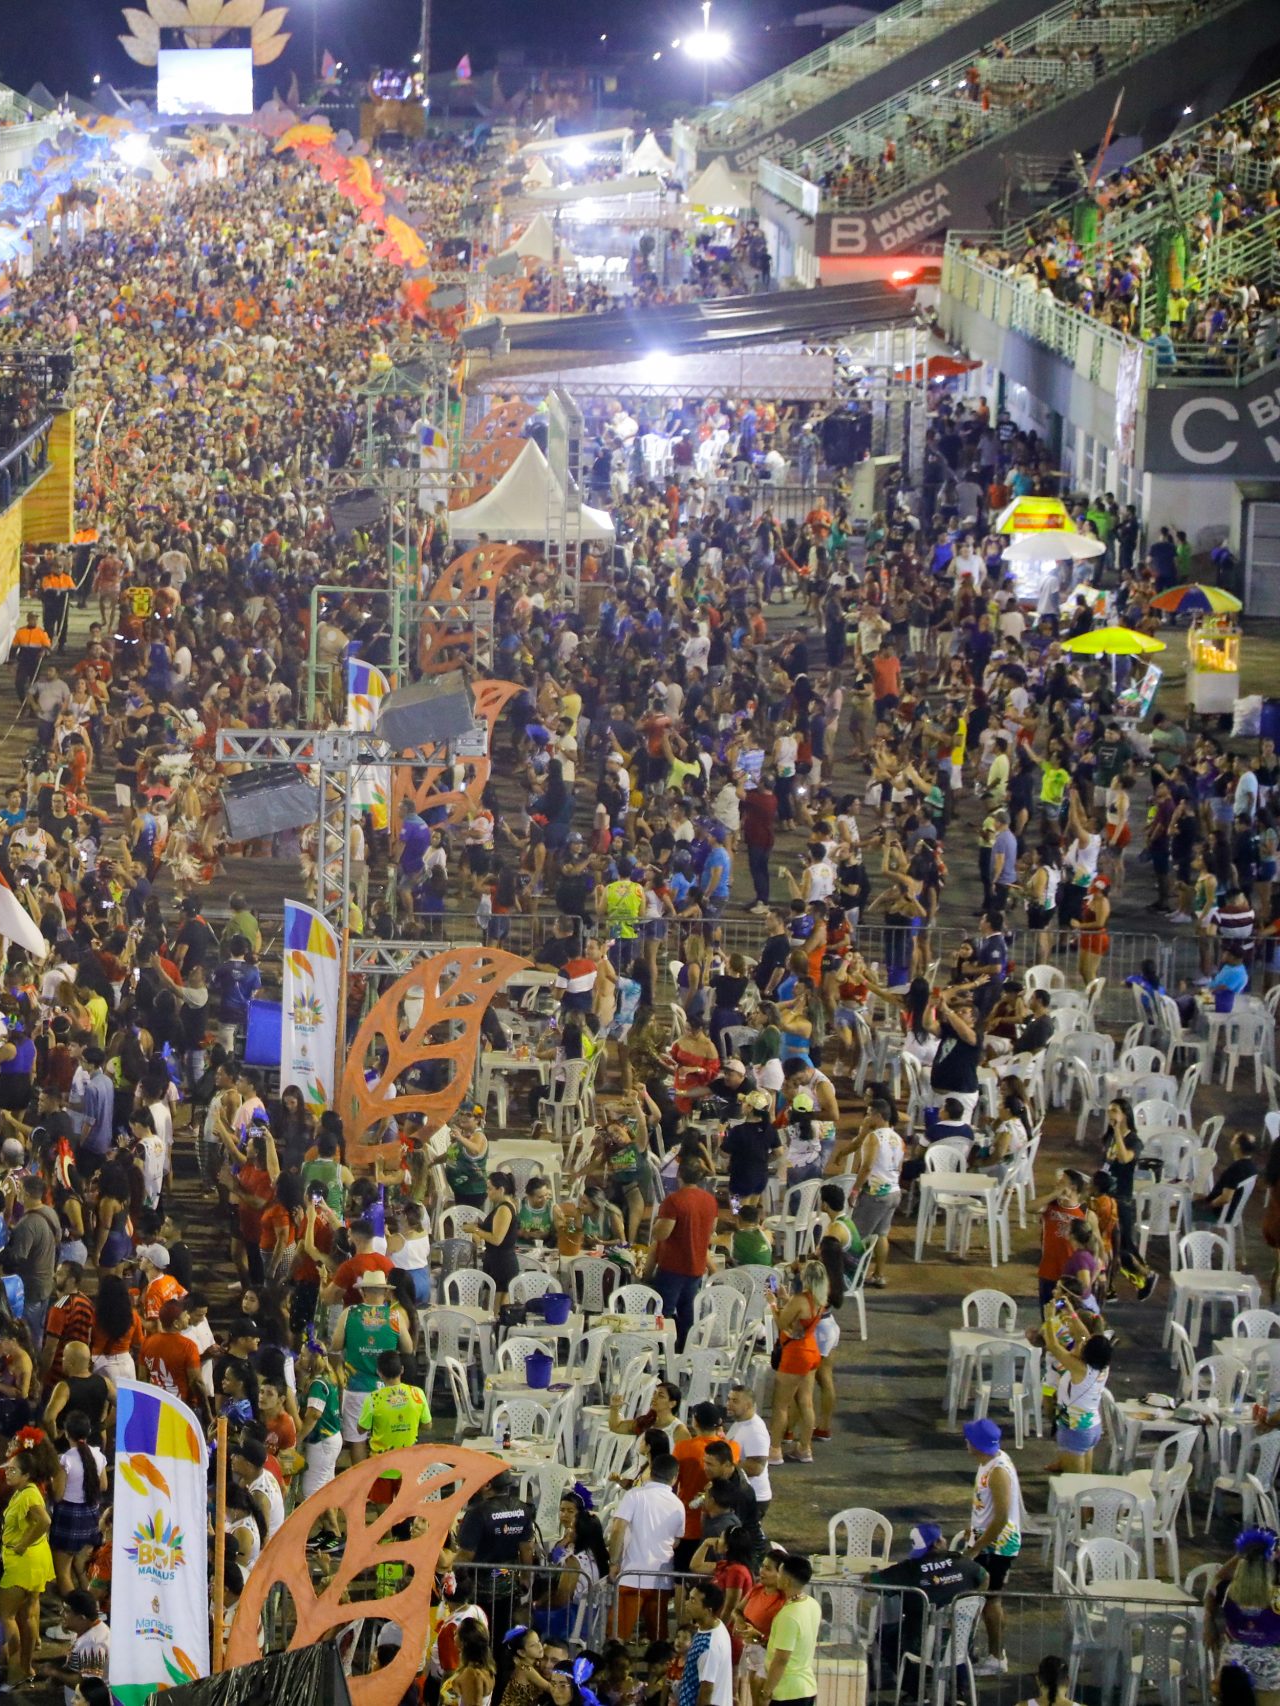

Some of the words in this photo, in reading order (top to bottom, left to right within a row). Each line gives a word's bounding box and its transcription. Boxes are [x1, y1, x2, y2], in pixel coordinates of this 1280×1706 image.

[830, 217, 868, 254] B
[1171, 397, 1240, 465] C
[920, 1558, 953, 1573] STAFF
[138, 1566, 175, 1581] MANAUS
[135, 1618, 174, 1633] Manaus
